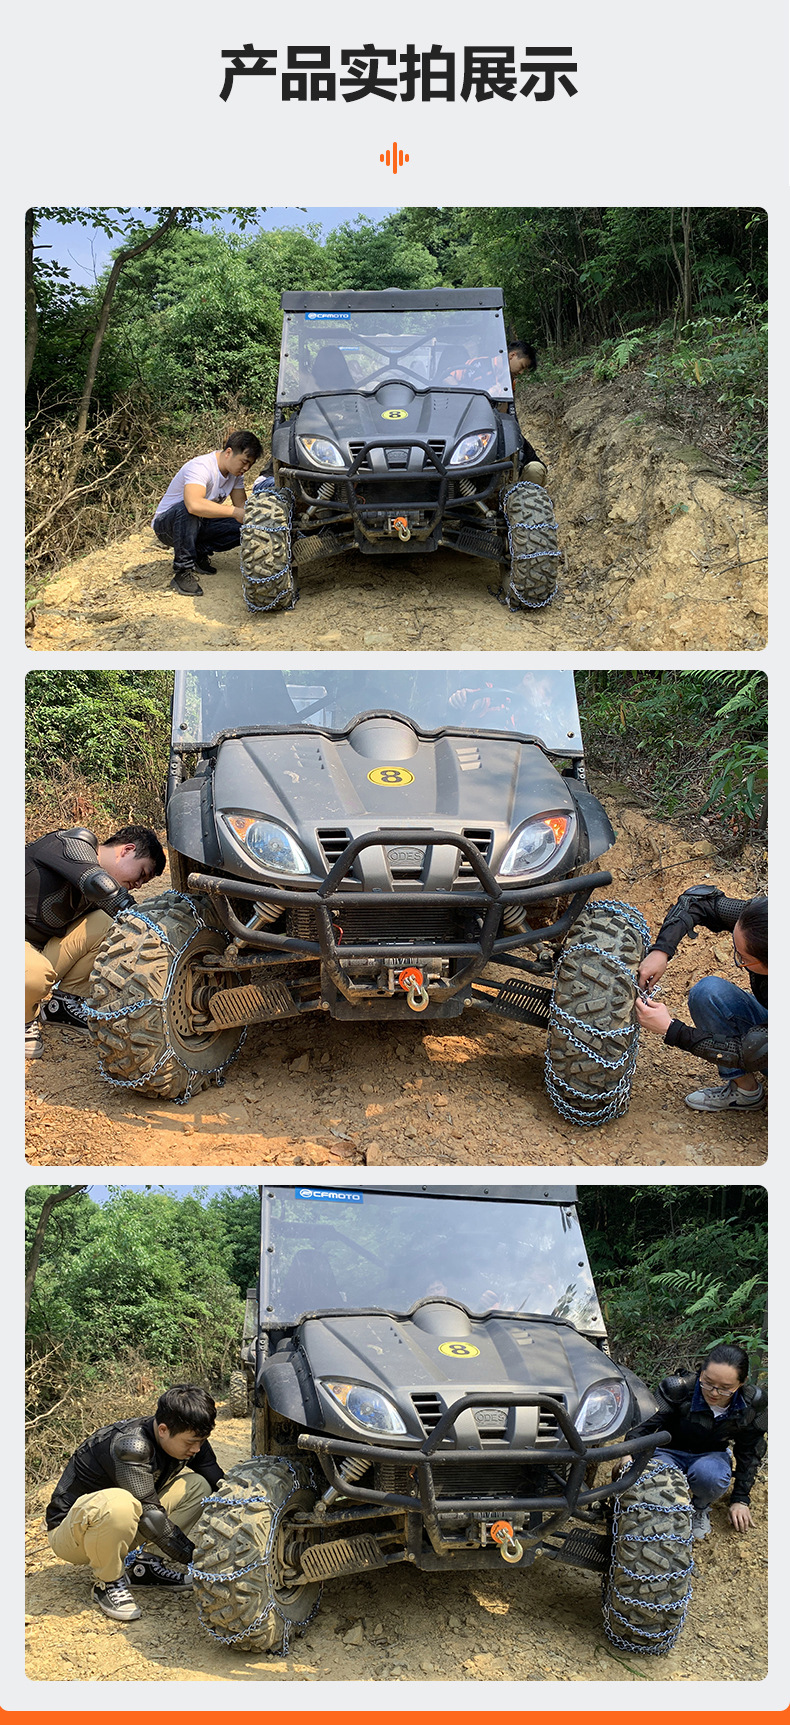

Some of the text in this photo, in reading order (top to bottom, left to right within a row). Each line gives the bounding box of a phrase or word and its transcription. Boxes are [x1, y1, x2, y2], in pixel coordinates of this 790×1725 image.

[380, 769, 403, 783] 8
[389, 851, 421, 861] ODES
[313, 1191, 360, 1200] CFMOTO
[449, 1344, 471, 1355] 8
[476, 1413, 505, 1422] ODES
